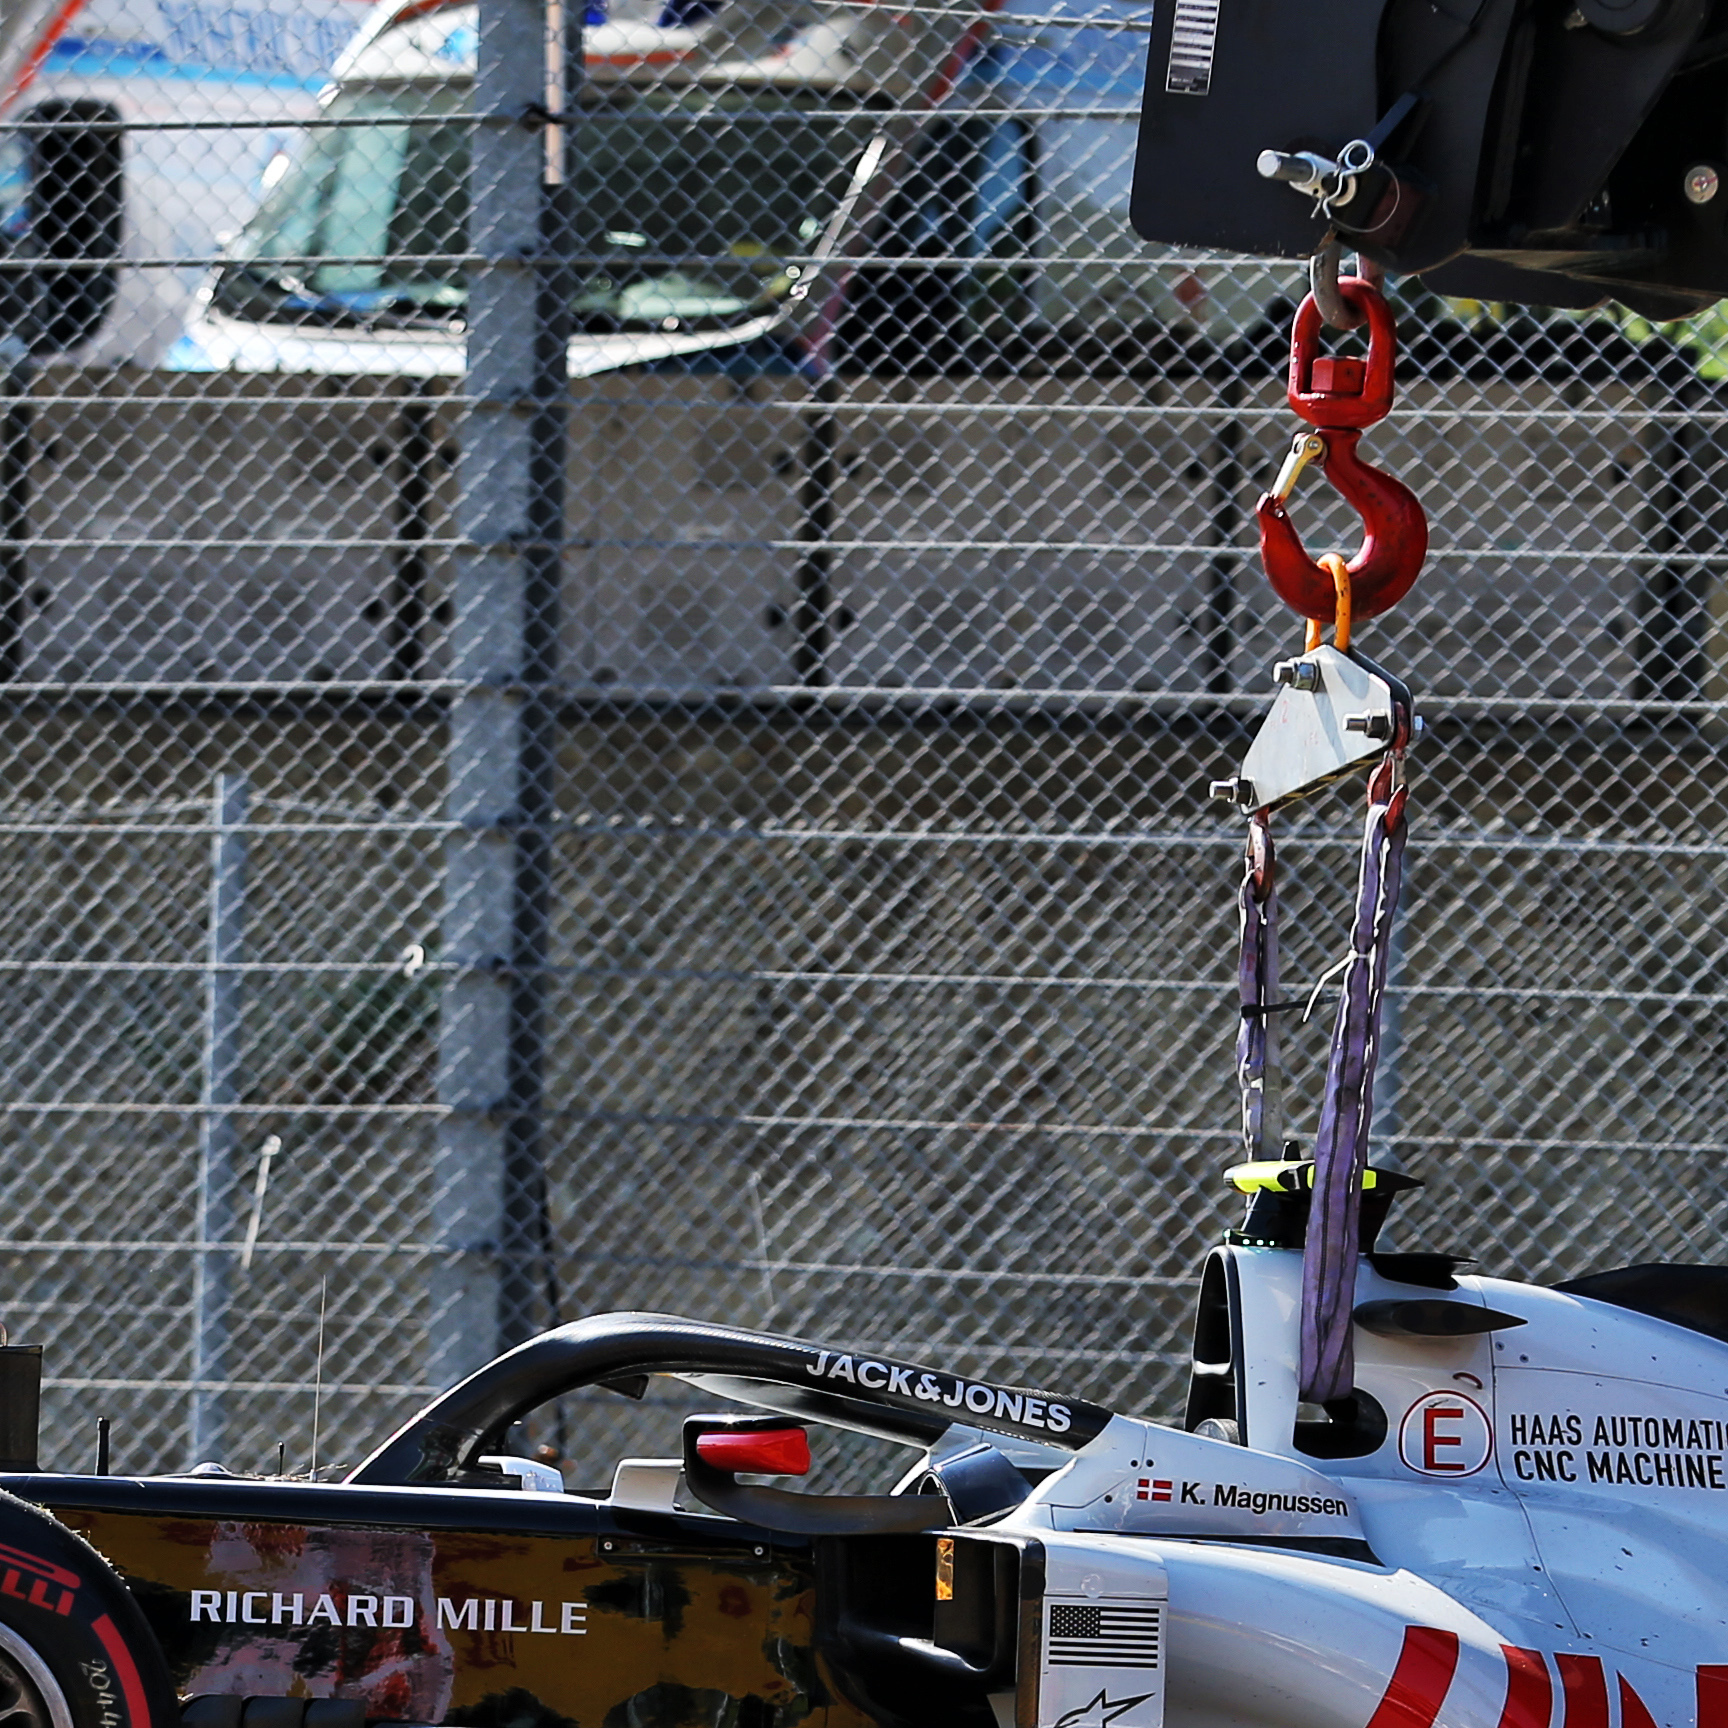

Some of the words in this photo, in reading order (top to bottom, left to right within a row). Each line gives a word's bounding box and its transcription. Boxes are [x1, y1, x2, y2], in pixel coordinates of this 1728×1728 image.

[805, 1350, 1072, 1434] JACK&JONES
[1424, 1408, 1465, 1471] E
[1510, 1415, 1582, 1447] HAAS
[1513, 1452, 1577, 1483] CNC
[1588, 1454, 1726, 1490] MACHINE
[1179, 1485, 1206, 1506] K.
[1213, 1485, 1349, 1518] Magnussen
[189, 1589, 414, 1630] RICHARD
[436, 1596, 589, 1635] MILLE
